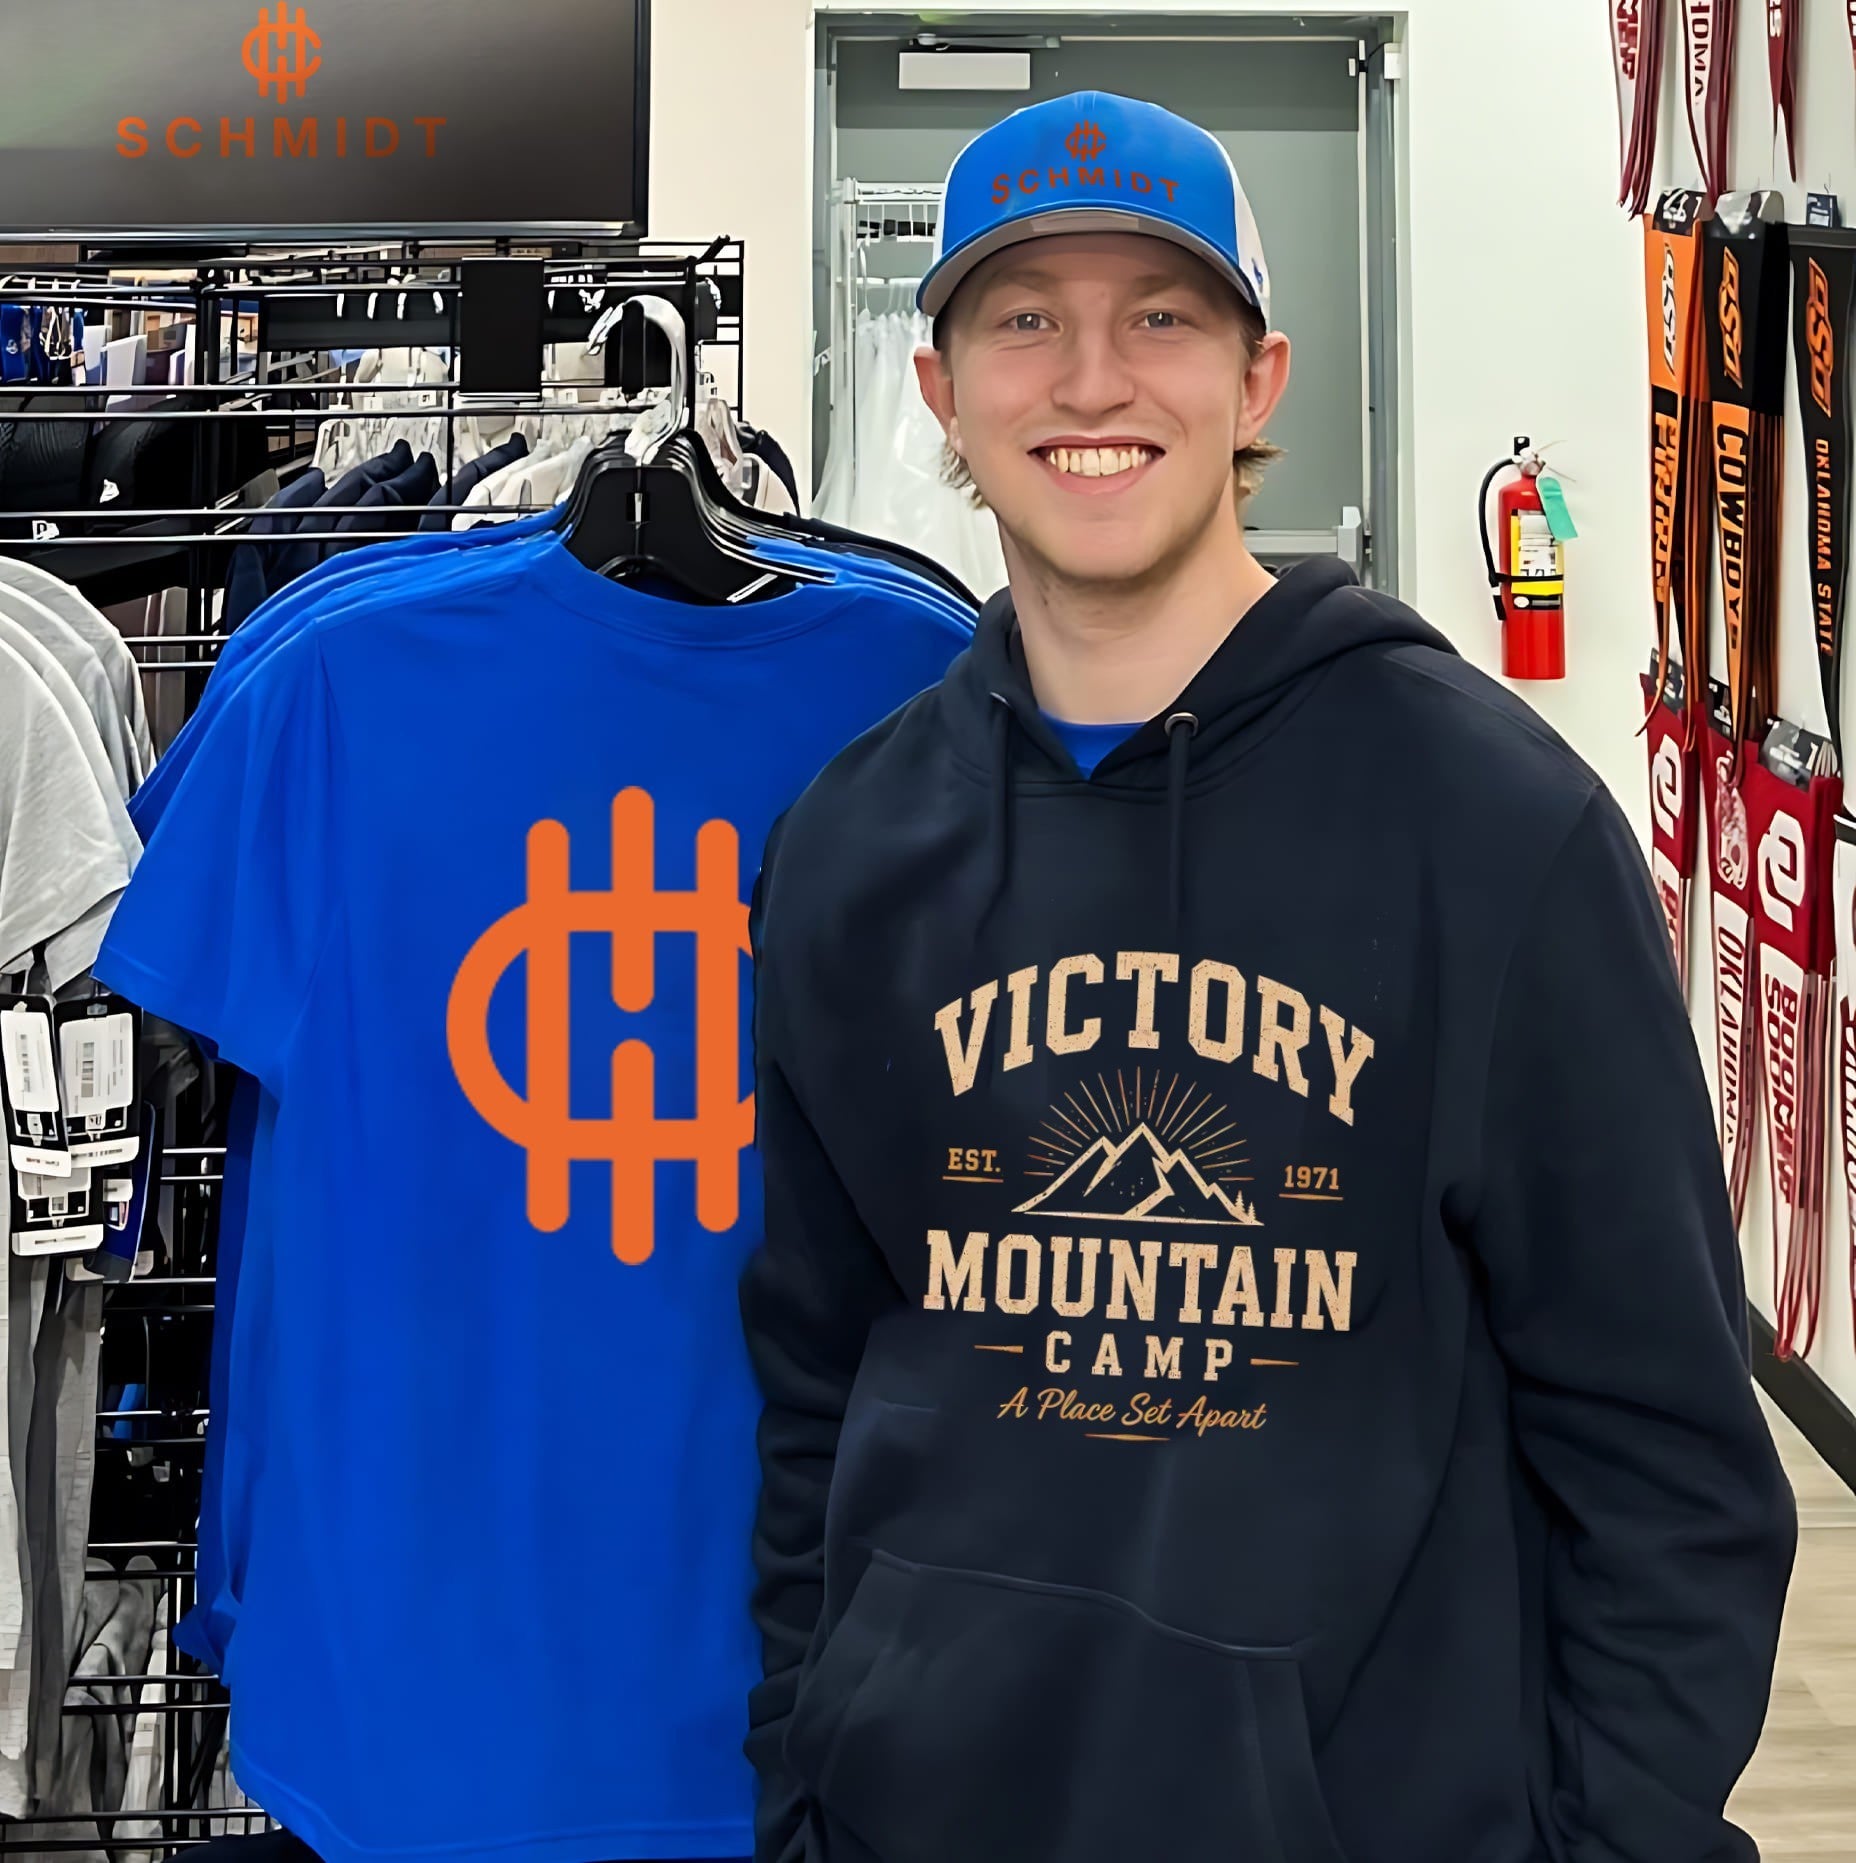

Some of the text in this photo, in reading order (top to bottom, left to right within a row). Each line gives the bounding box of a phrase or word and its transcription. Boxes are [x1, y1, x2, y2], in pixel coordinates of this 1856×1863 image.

[115, 115, 447, 159] SCHMIDT
[991, 167, 1178, 204] SCHMIDT
[1815, 438, 1832, 571] OKLAHOMA
[934, 950, 1375, 1127] VICTORY
[947, 1147, 1002, 1173] EST.
[1284, 1164, 1340, 1191] 1971
[923, 1229, 1358, 1332] MOUNTAIN
[1045, 1330, 1233, 1381] CAMP
[997, 1386, 1268, 1437] A Place Set Apart
